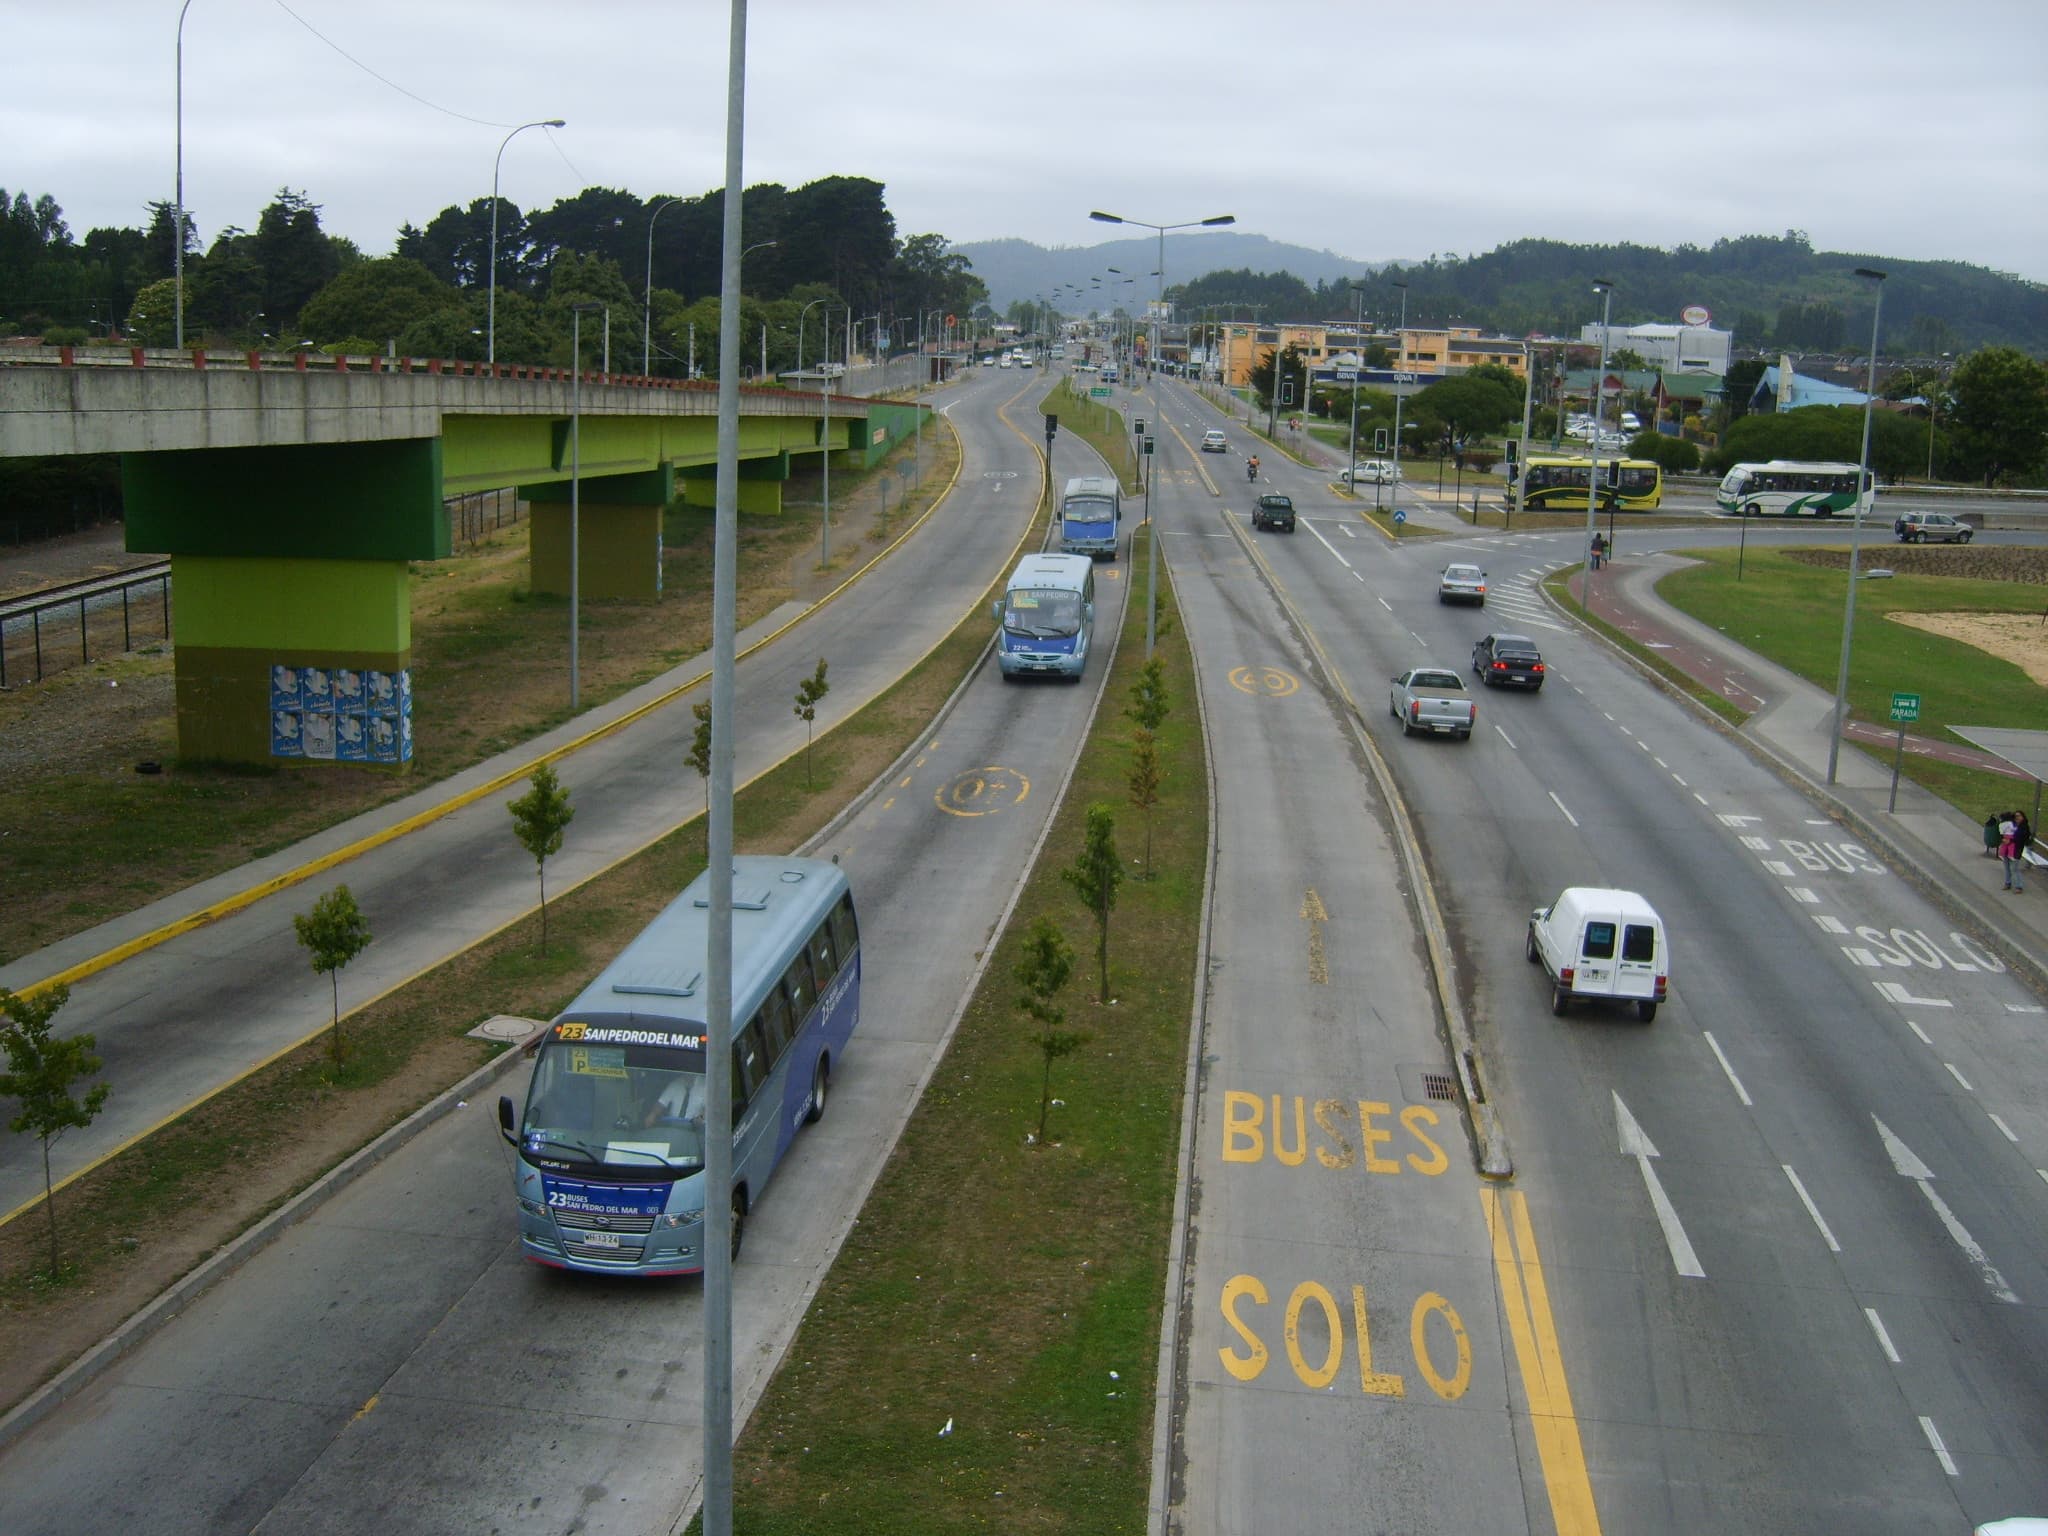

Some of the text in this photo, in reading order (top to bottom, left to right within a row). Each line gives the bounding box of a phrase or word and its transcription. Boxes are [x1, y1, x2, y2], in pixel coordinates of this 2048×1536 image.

[1336, 372, 1355, 380] BBVA
[1891, 708, 1917, 718] PARADA
[1779, 839, 1888, 875] BUS
[1855, 926, 2006, 973] SOLO
[562, 1026, 583, 1039] 23
[584, 1028, 608, 1041] SAN
[671, 1034, 699, 1048] MAR
[577, 1061, 586, 1072] P
[1222, 1090, 1448, 1176] BUSES
[548, 1191, 588, 1207] 23 BUSES
[566, 1201, 581, 1210] SAN
[582, 1203, 605, 1213] PEDRO
[606, 1205, 620, 1213] DEL
[1219, 1274, 1472, 1401] SOLO
